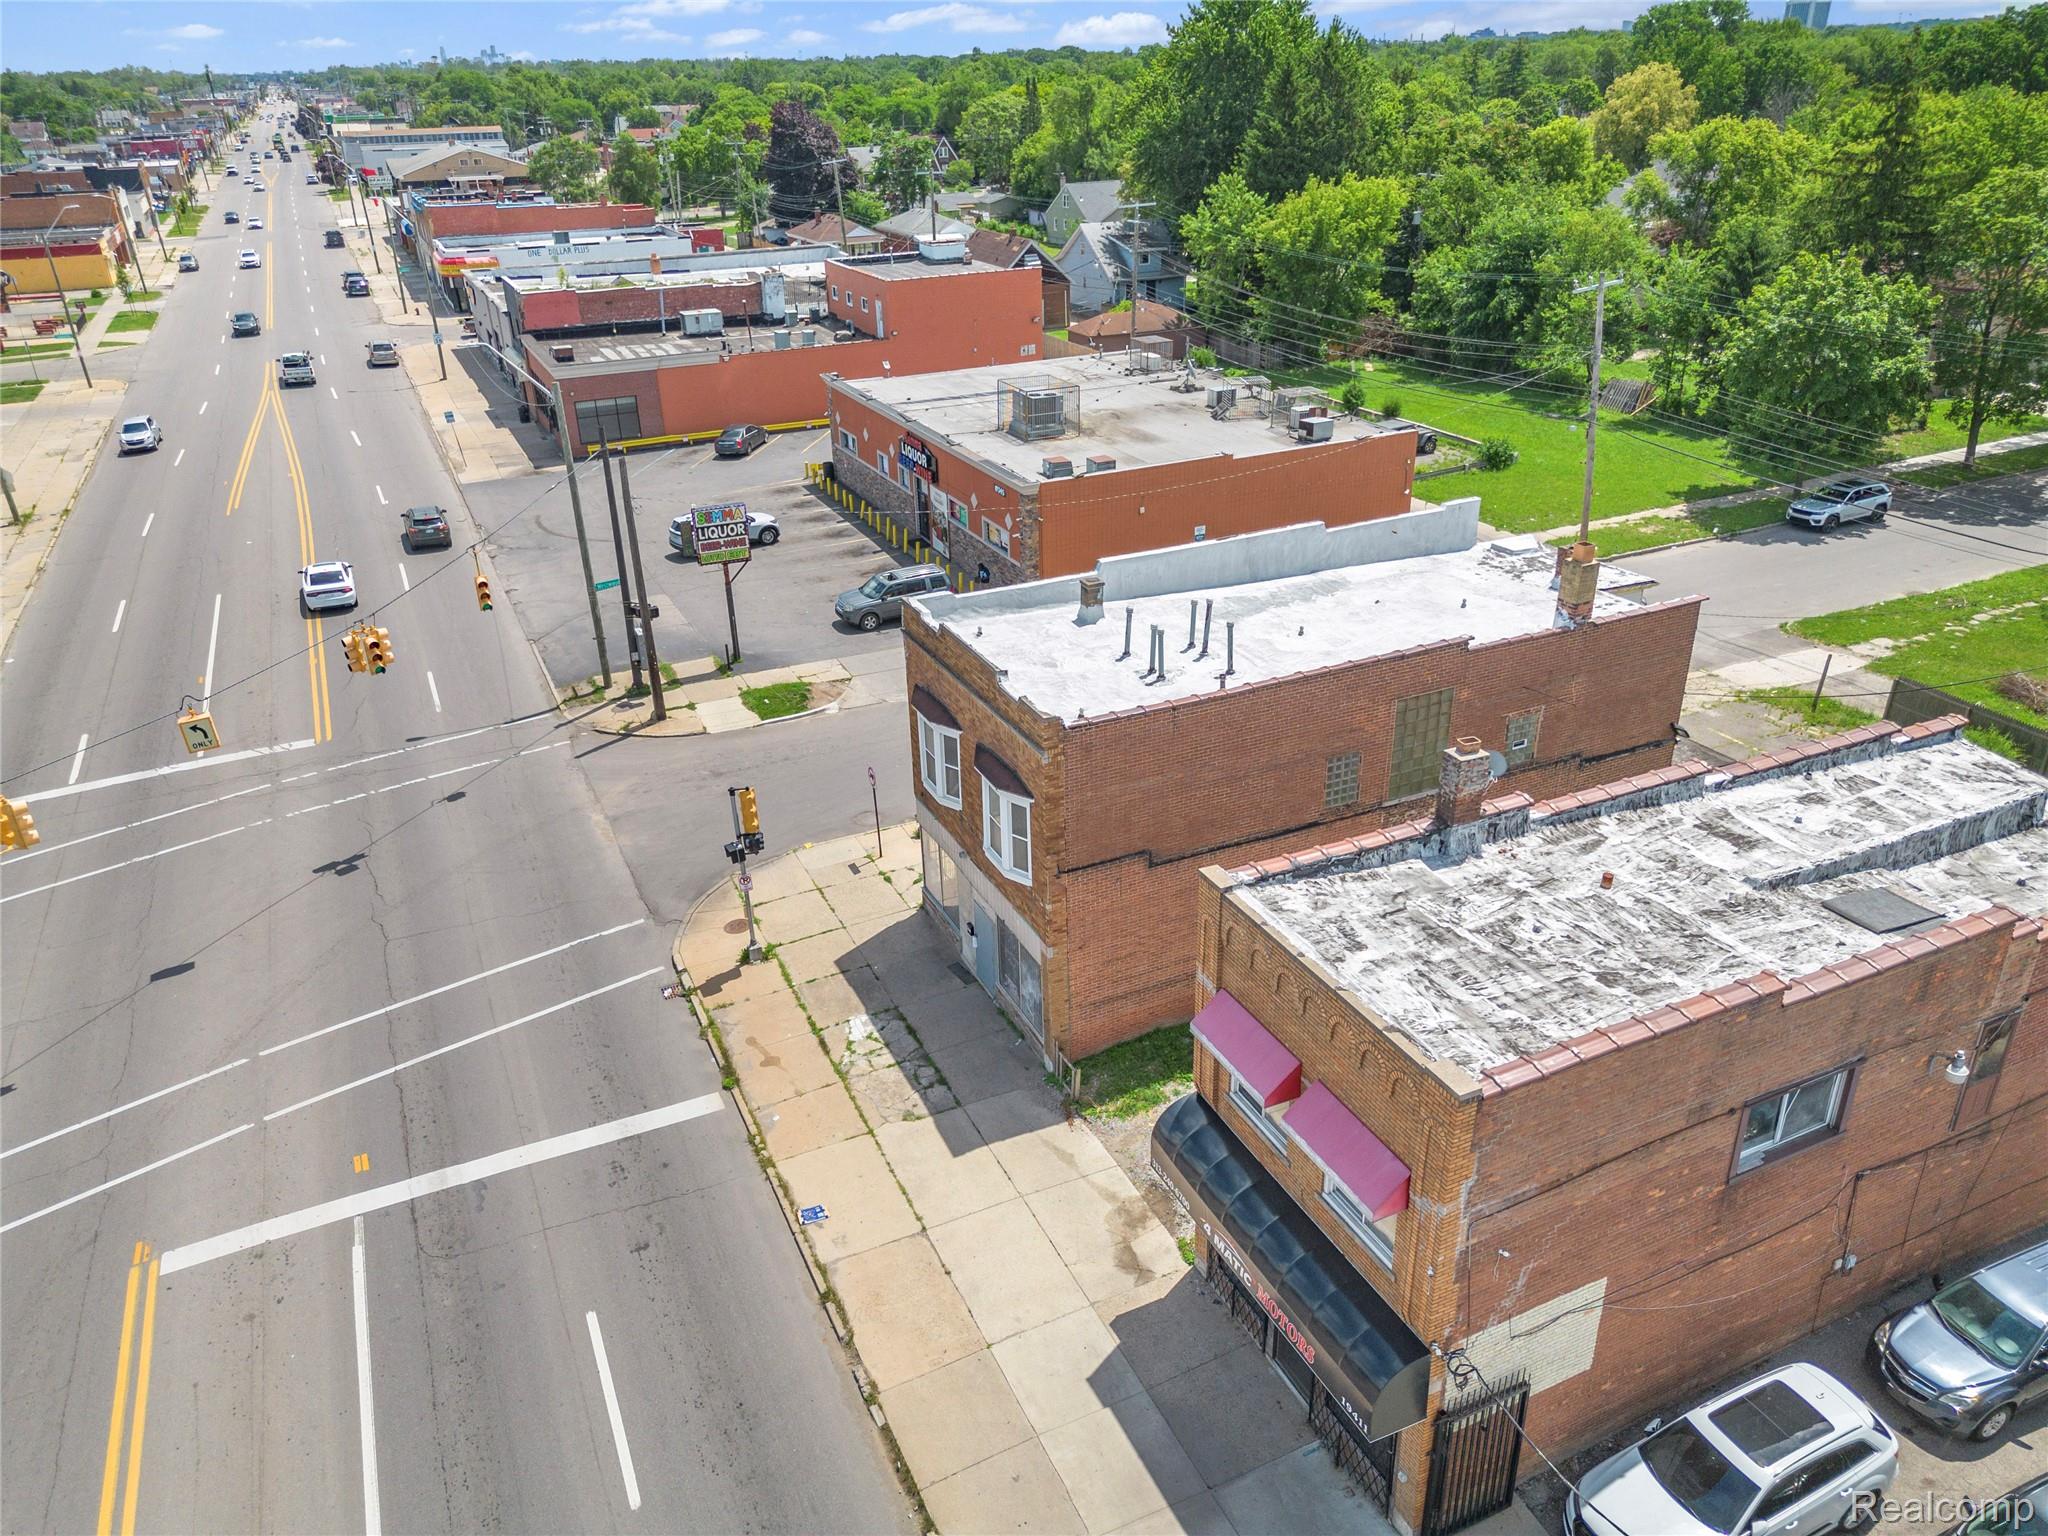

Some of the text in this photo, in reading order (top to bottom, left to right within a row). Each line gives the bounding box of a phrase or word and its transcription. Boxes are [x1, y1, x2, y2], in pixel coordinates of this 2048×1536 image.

[527, 245, 590, 257] ONE DOLLAR PLUS
[901, 441, 928, 468] LIQUOR
[698, 523, 746, 540] LIQUOR
[192, 739, 213, 750] ONLY
[1213, 1234, 1252, 1287] MATIC
[1256, 1286, 1316, 1365] MOTORS
